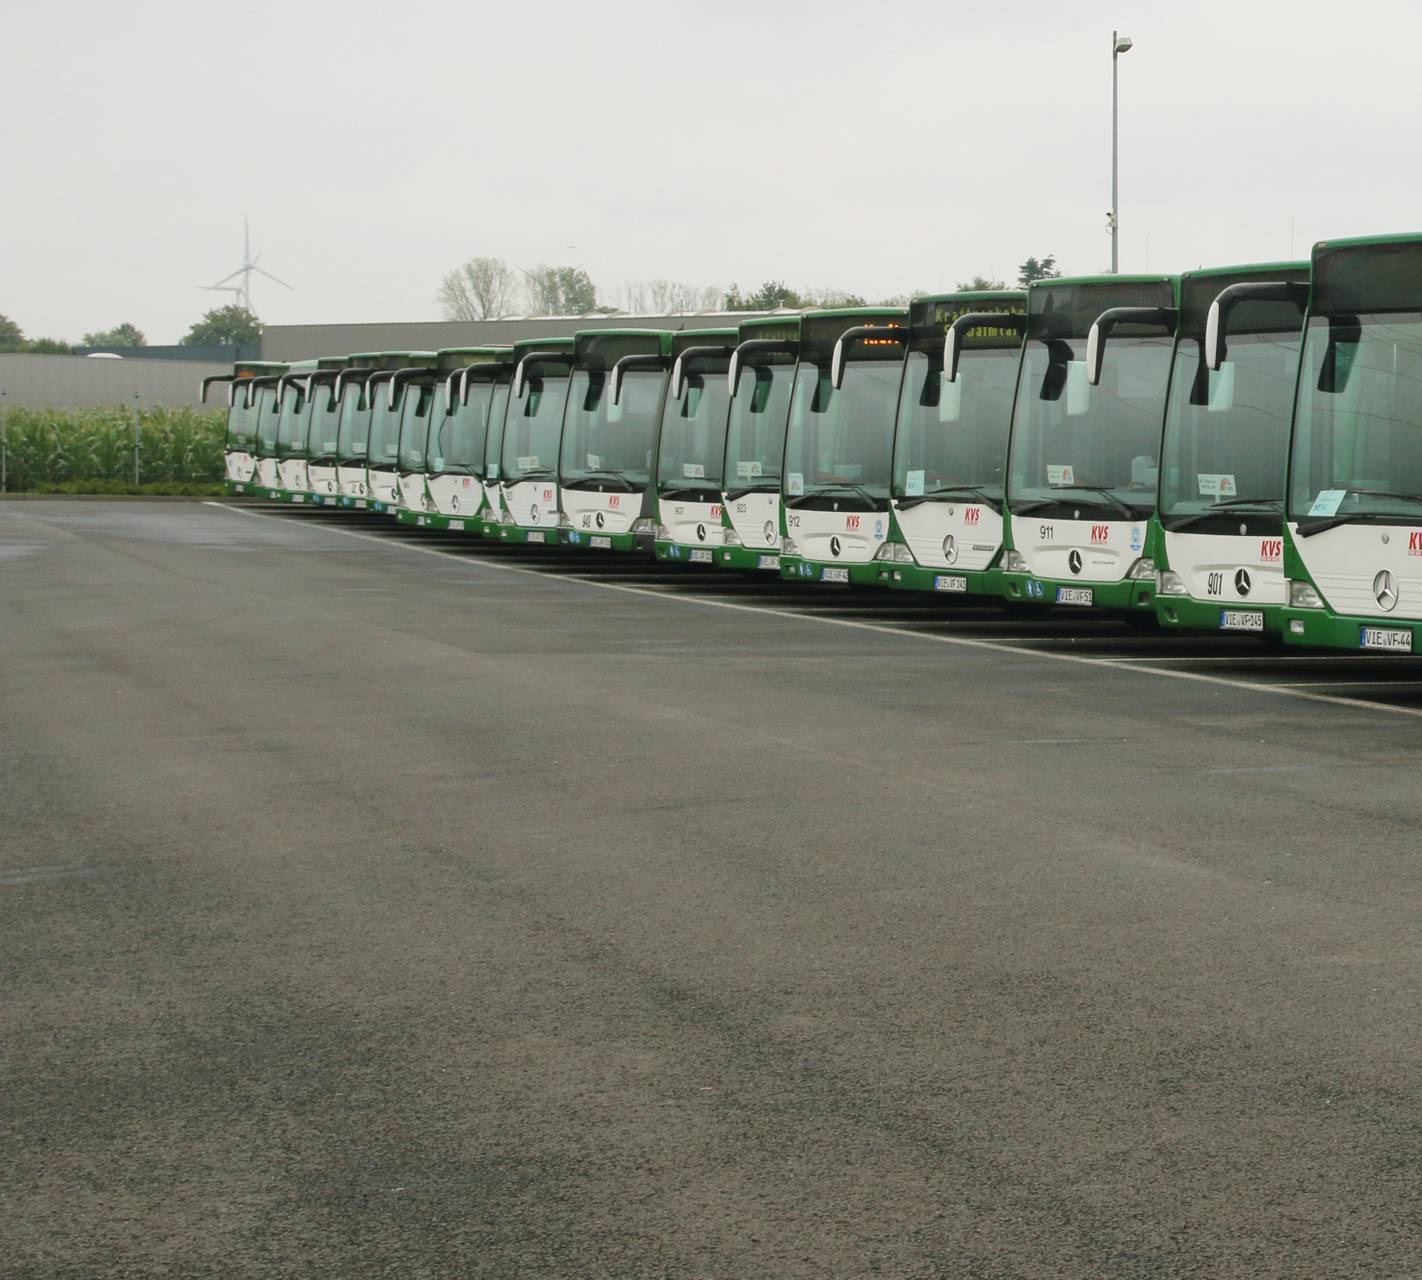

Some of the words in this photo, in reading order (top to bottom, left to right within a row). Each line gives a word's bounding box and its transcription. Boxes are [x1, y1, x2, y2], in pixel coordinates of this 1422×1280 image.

[965, 507, 980, 521] KVS
[1039, 525, 1054, 540] 911
[1091, 525, 1109, 540] KVS
[1261, 540, 1282, 557] KVS
[1207, 572, 1223, 596] 901
[1365, 631, 1382, 645] VIE
[1387, 632, 1399, 646] VF
[1400, 633, 1411, 647] 44
